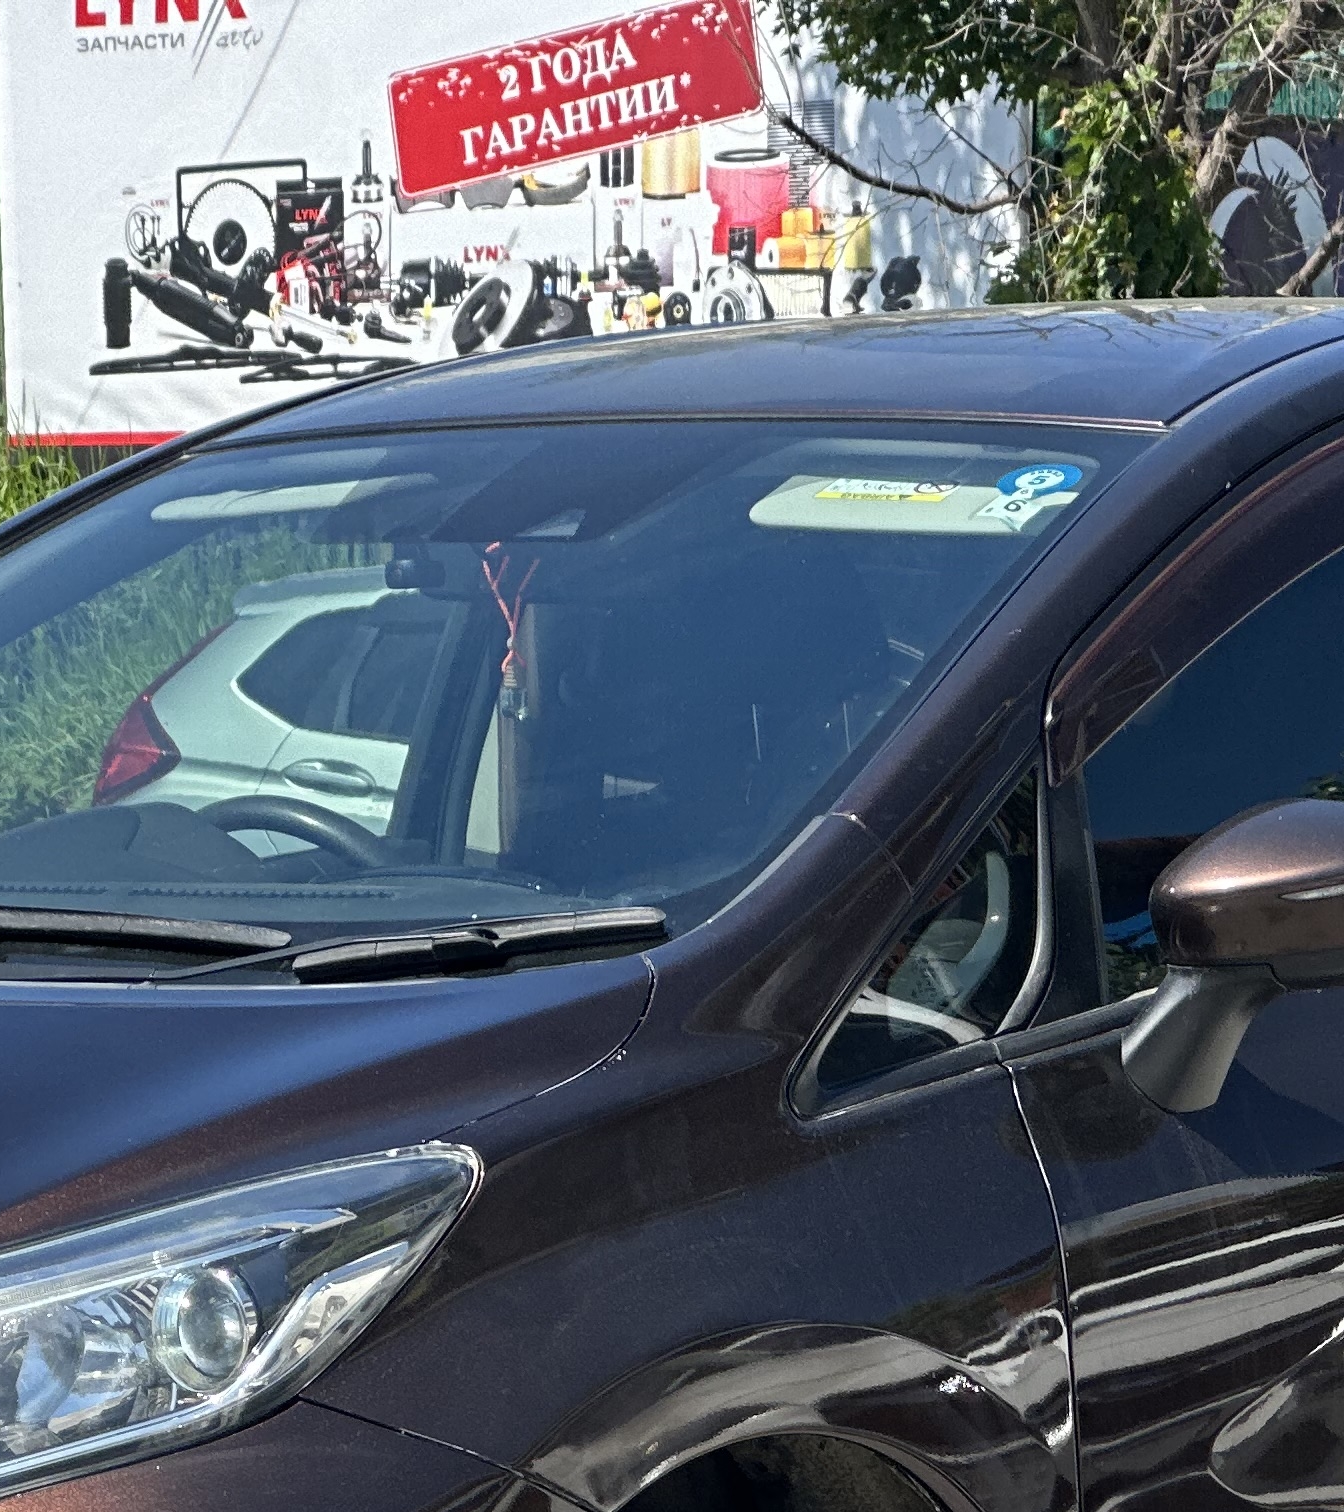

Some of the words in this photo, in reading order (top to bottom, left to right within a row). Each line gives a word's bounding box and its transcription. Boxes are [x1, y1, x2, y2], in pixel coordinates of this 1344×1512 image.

[76, 33, 185, 52] ЗАПЧАСТИ
[498, 64, 521, 101] 2
[528, 30, 638, 90] ГОДА
[463, 245, 512, 263] LYNX
